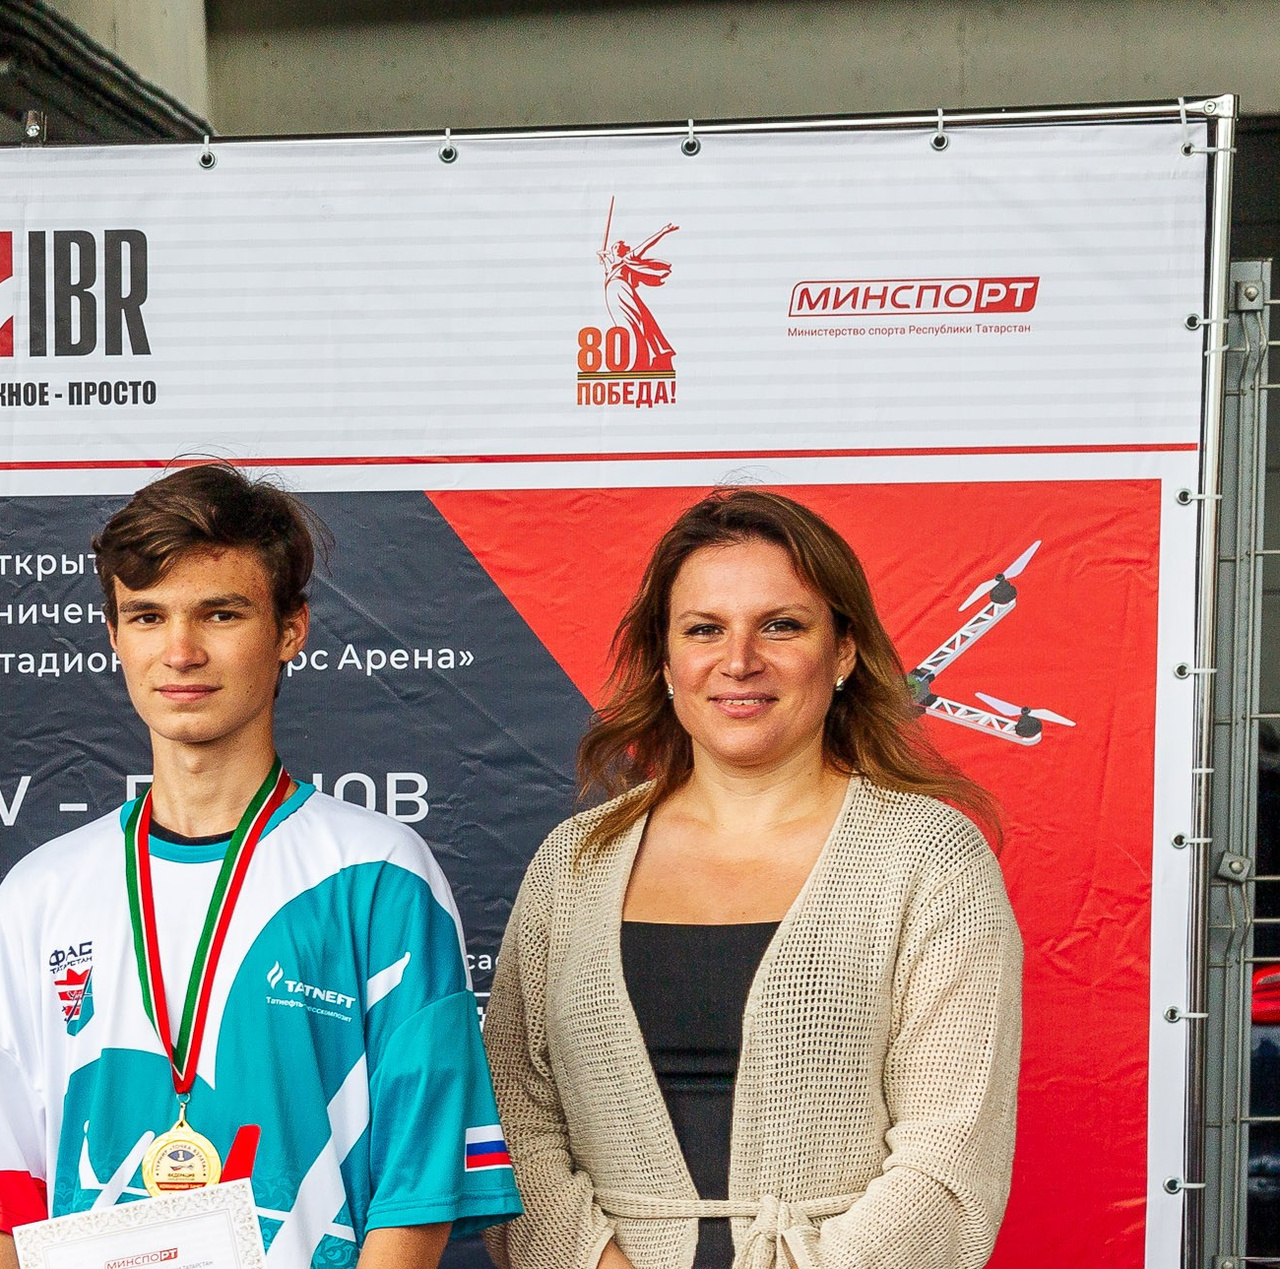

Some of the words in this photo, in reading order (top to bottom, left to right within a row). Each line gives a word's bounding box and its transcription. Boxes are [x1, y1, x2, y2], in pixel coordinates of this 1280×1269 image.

[29, 229, 151, 357] IBR
[797, 282, 1035, 311] МИНСПОРТ
[787, 326, 866, 338] Министерство
[868, 327, 906, 338] спорта
[908, 324, 973, 337] Республики
[975, 323, 1031, 336] Татарстан
[577, 326, 630, 372] 80
[68, 380, 157, 406] ПРОСТО
[577, 381, 676, 409] ПОБЕДА!
[337, 643, 475, 677] Арена»
[49, 941, 93, 967] ФАС
[284, 980, 356, 1009] TATNEFT
[177, 1150, 185, 1161] 1
